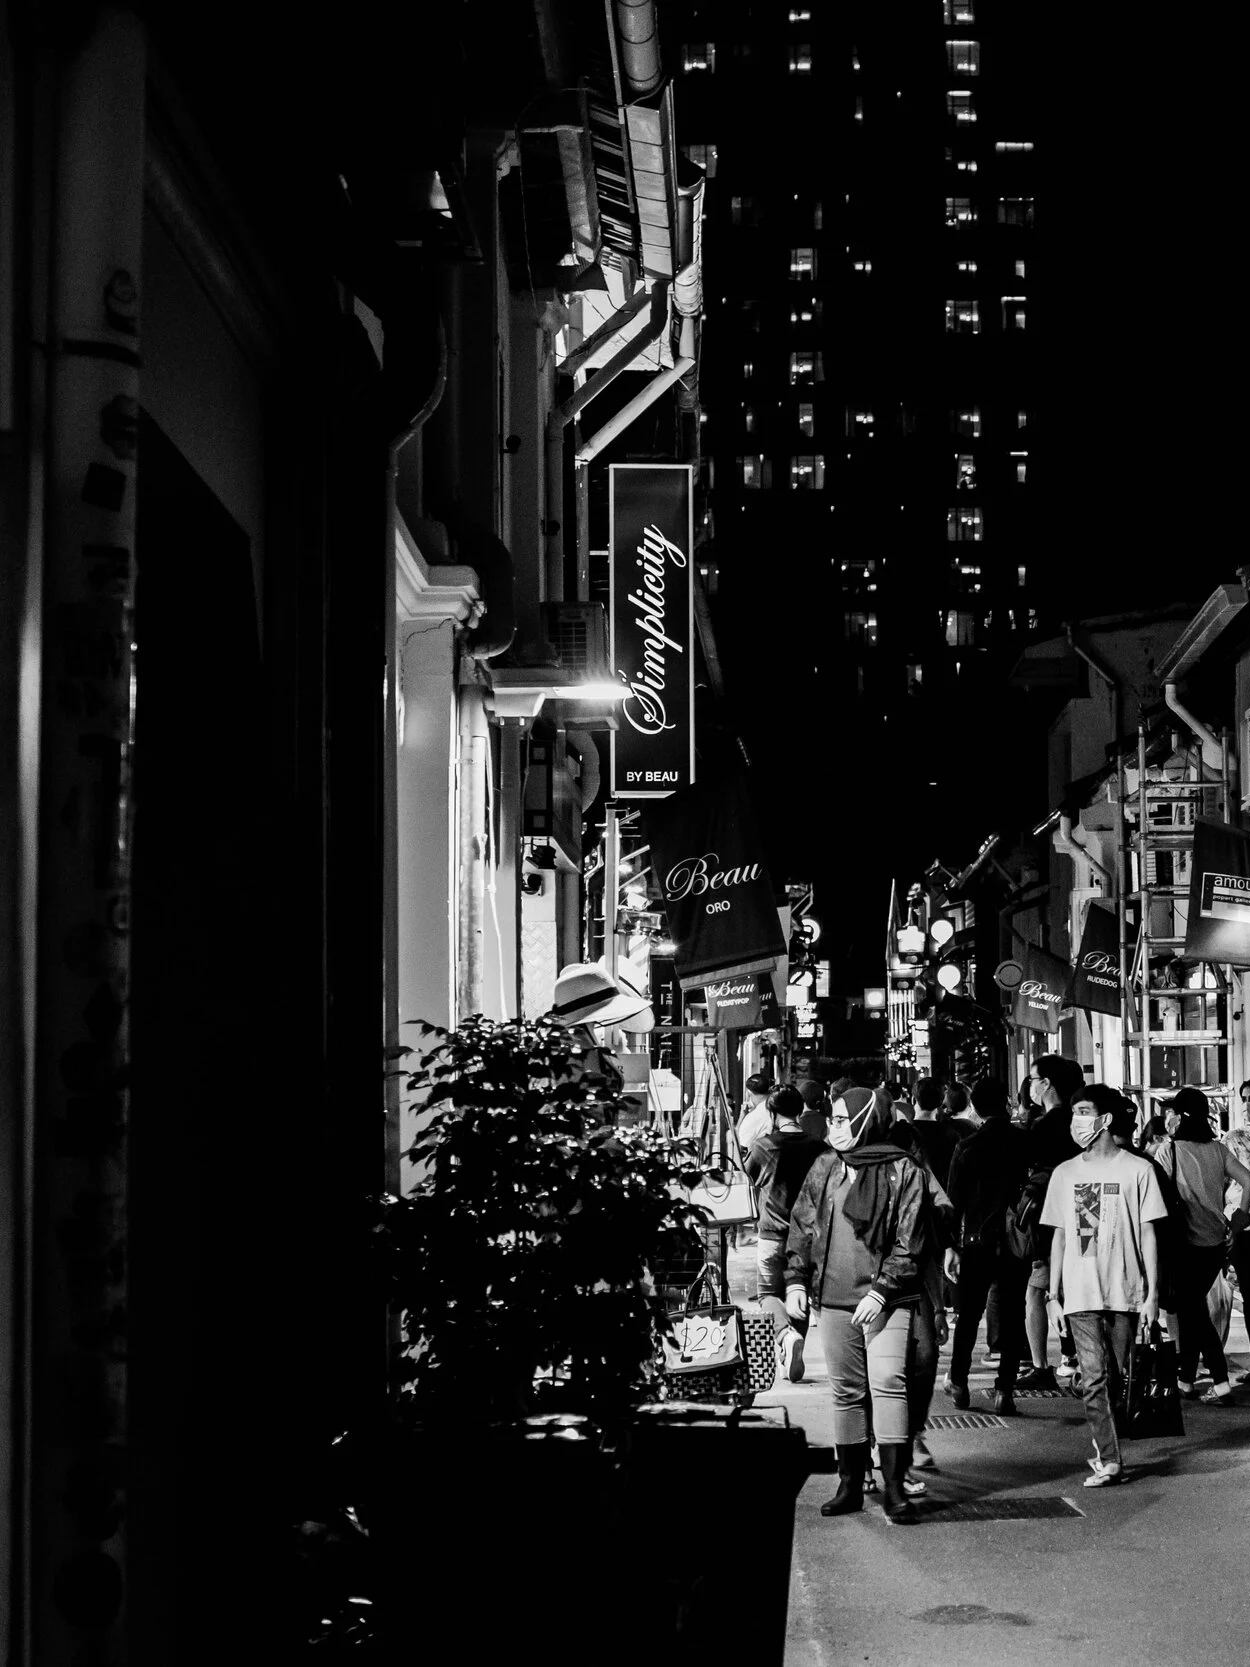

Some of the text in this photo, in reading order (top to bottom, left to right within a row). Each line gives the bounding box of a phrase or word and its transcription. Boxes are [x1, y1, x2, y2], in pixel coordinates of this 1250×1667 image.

[619, 524, 687, 735] Simplicity
[626, 771, 678, 782] BY BEAU
[665, 853, 763, 902] Beau
[706, 900, 731, 915] ORO
[1081, 950, 1121, 977] Bea
[708, 981, 755, 998] Beau
[1019, 980, 1061, 1003] Beau
[1087, 975, 1118, 989] RUDEDOG
[680, 1322, 722, 1352] $20
